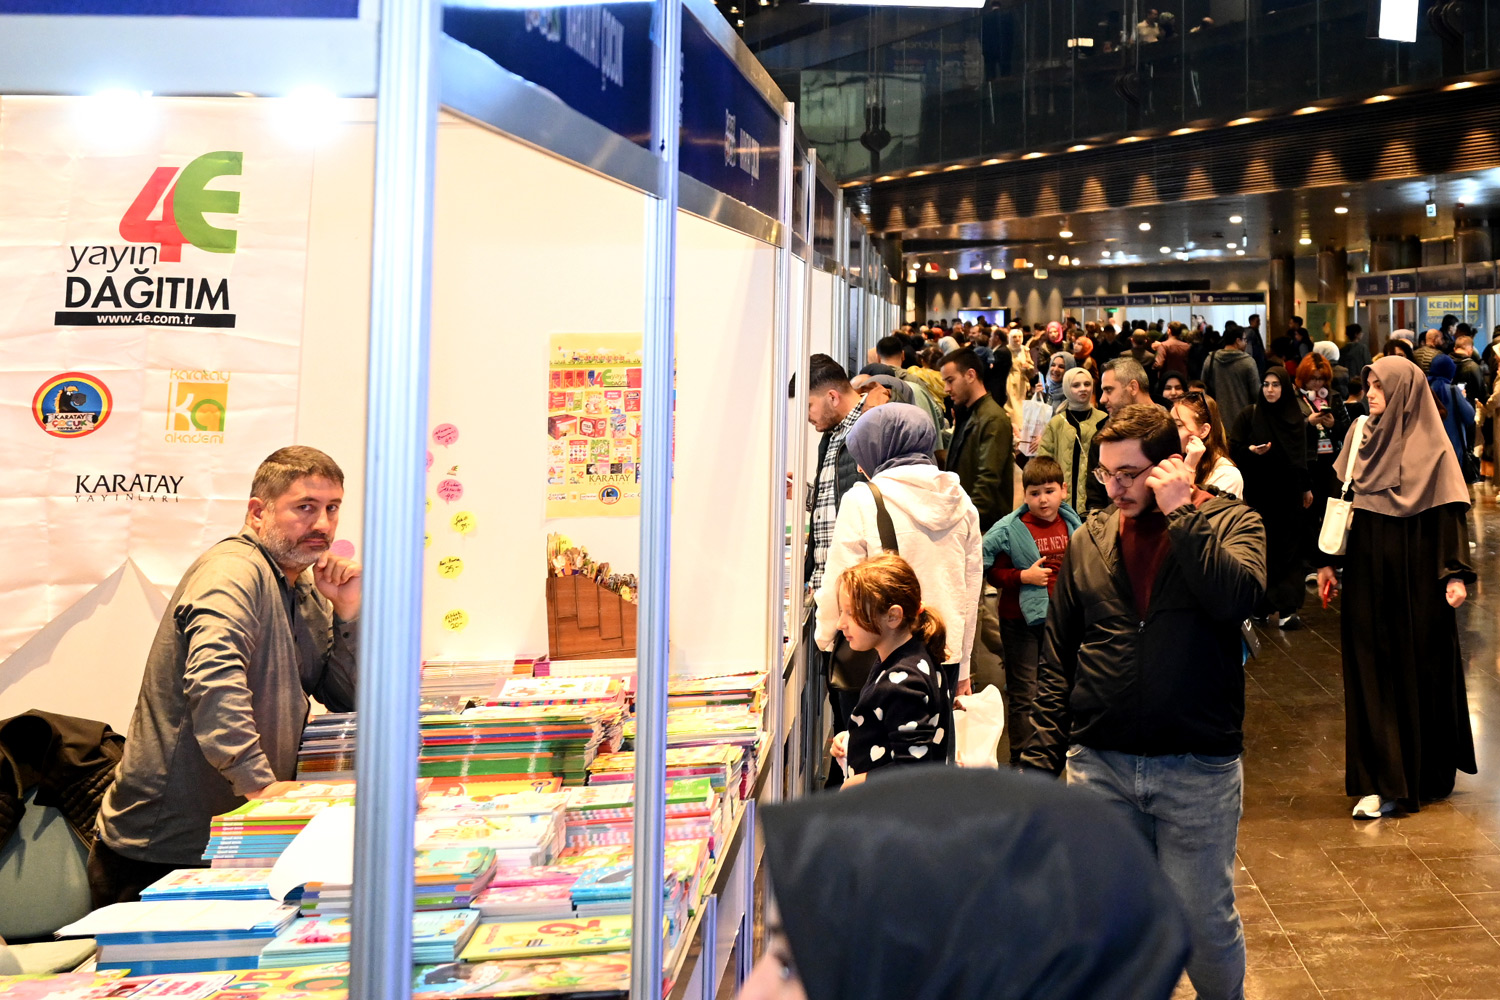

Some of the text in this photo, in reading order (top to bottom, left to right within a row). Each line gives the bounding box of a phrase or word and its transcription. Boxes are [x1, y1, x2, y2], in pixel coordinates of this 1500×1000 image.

[66, 245, 158, 273] yayın
[65, 268, 229, 311] DAĞITIM
[1428, 299, 1476, 309] KERİMN
[96, 313, 195, 325] www.4e.com.tr
[169, 367, 231, 383] karatay
[52, 420, 88, 428] ÇOCUK
[165, 433, 224, 444] akademi
[75, 473, 184, 494] KARATAY
[589, 474, 631, 483] KARATAY
[74, 493, 179, 503] YAYINLARI
